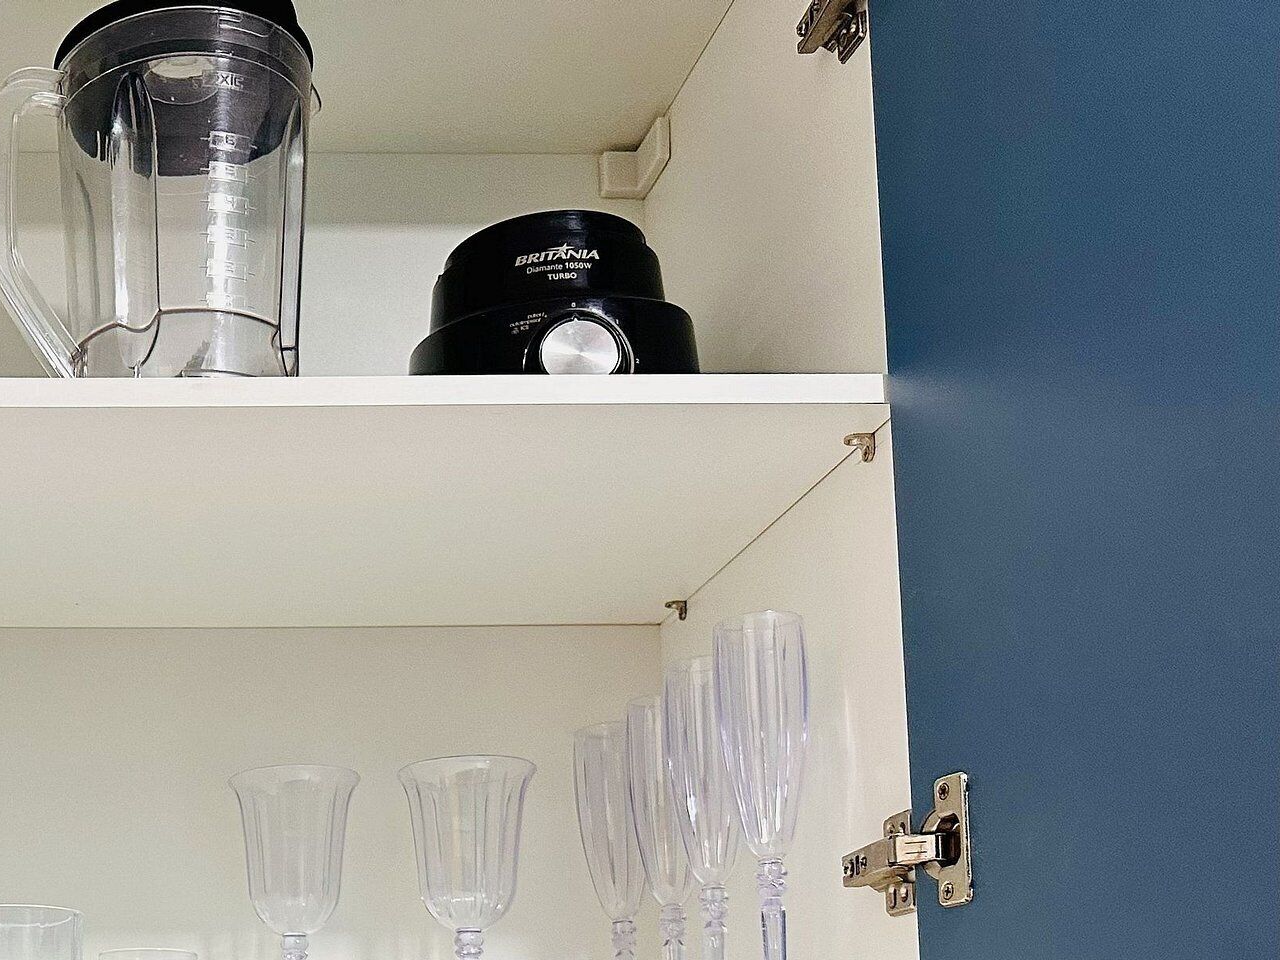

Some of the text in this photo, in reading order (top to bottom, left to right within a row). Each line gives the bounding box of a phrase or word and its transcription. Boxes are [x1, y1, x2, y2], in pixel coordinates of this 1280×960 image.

[526, 262, 592, 275] Diamante 1050W
[547, 272, 577, 280] TURBO
